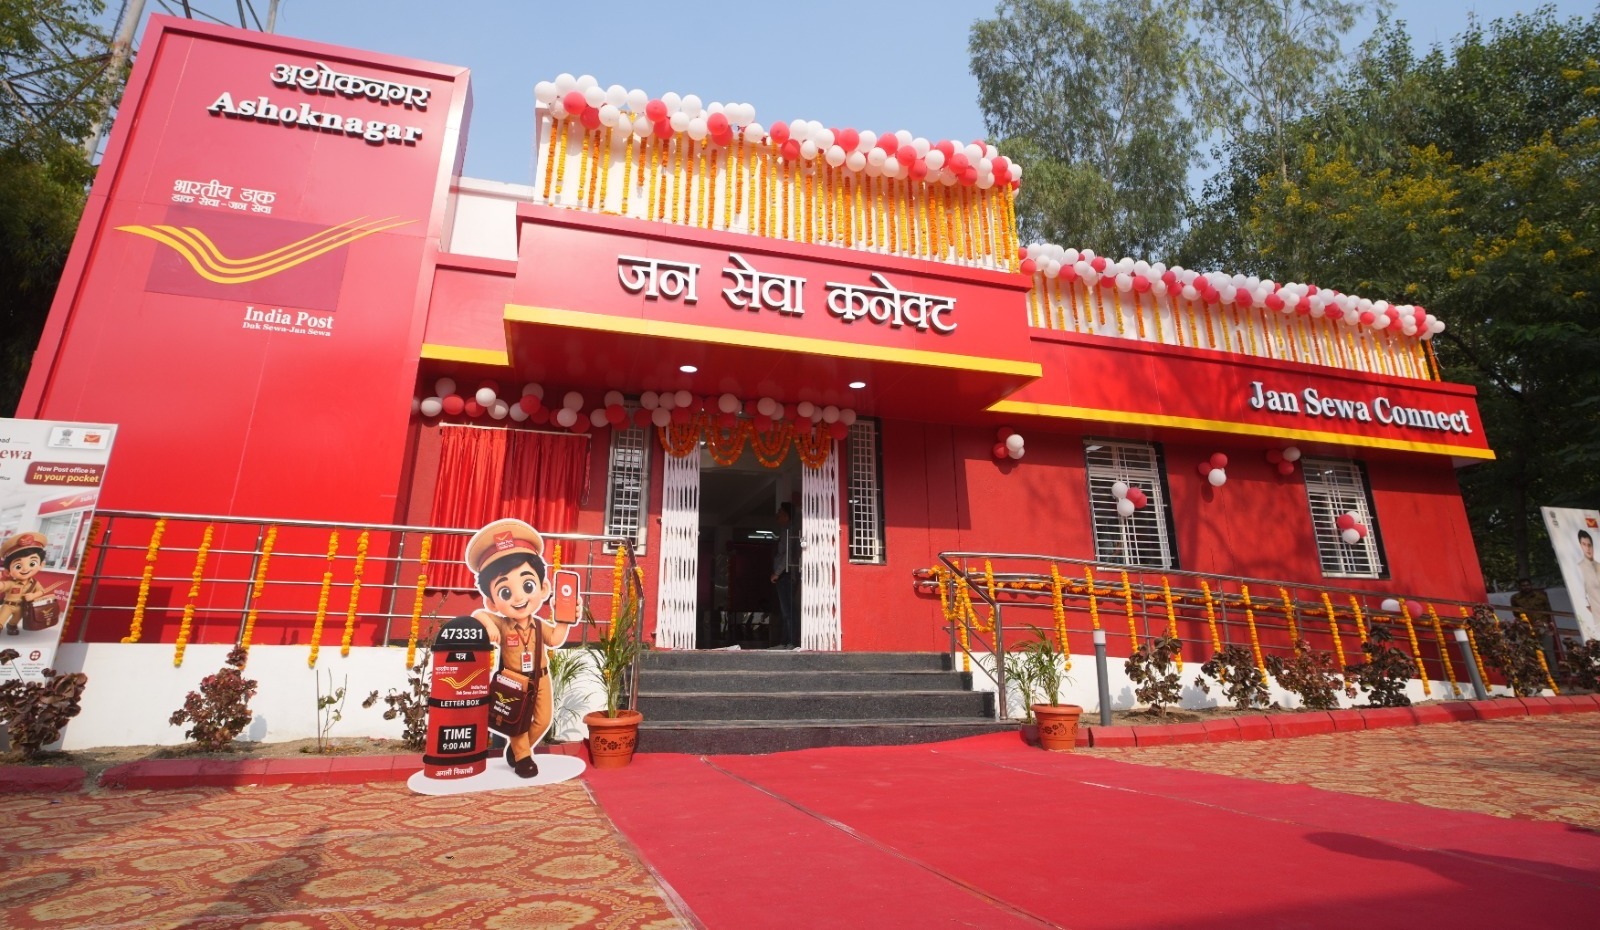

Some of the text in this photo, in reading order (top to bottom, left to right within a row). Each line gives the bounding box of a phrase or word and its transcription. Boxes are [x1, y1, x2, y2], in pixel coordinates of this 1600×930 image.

[270, 62, 431, 109] अशोकनगर
[207, 92, 423, 144] Ashoknagar
[173, 179, 276, 204] भारतीय डाक
[171, 193, 195, 203] डाक
[251, 203, 273, 214] सेवा
[617, 252, 958, 335] जन सेवा कनेक्ट
[244, 306, 334, 329] India Post
[307, 328, 331, 337] Sewa
[1250, 380, 1473, 434] Jan Sewa Connect
[0, 450, 32, 460] ewa
[33, 472, 99, 483] in your pocket
[441, 628, 483, 640] 473331
[455, 652, 467, 661] पत्र
[443, 727, 472, 740] TIME
[442, 741, 471, 751] 9:00 AM
